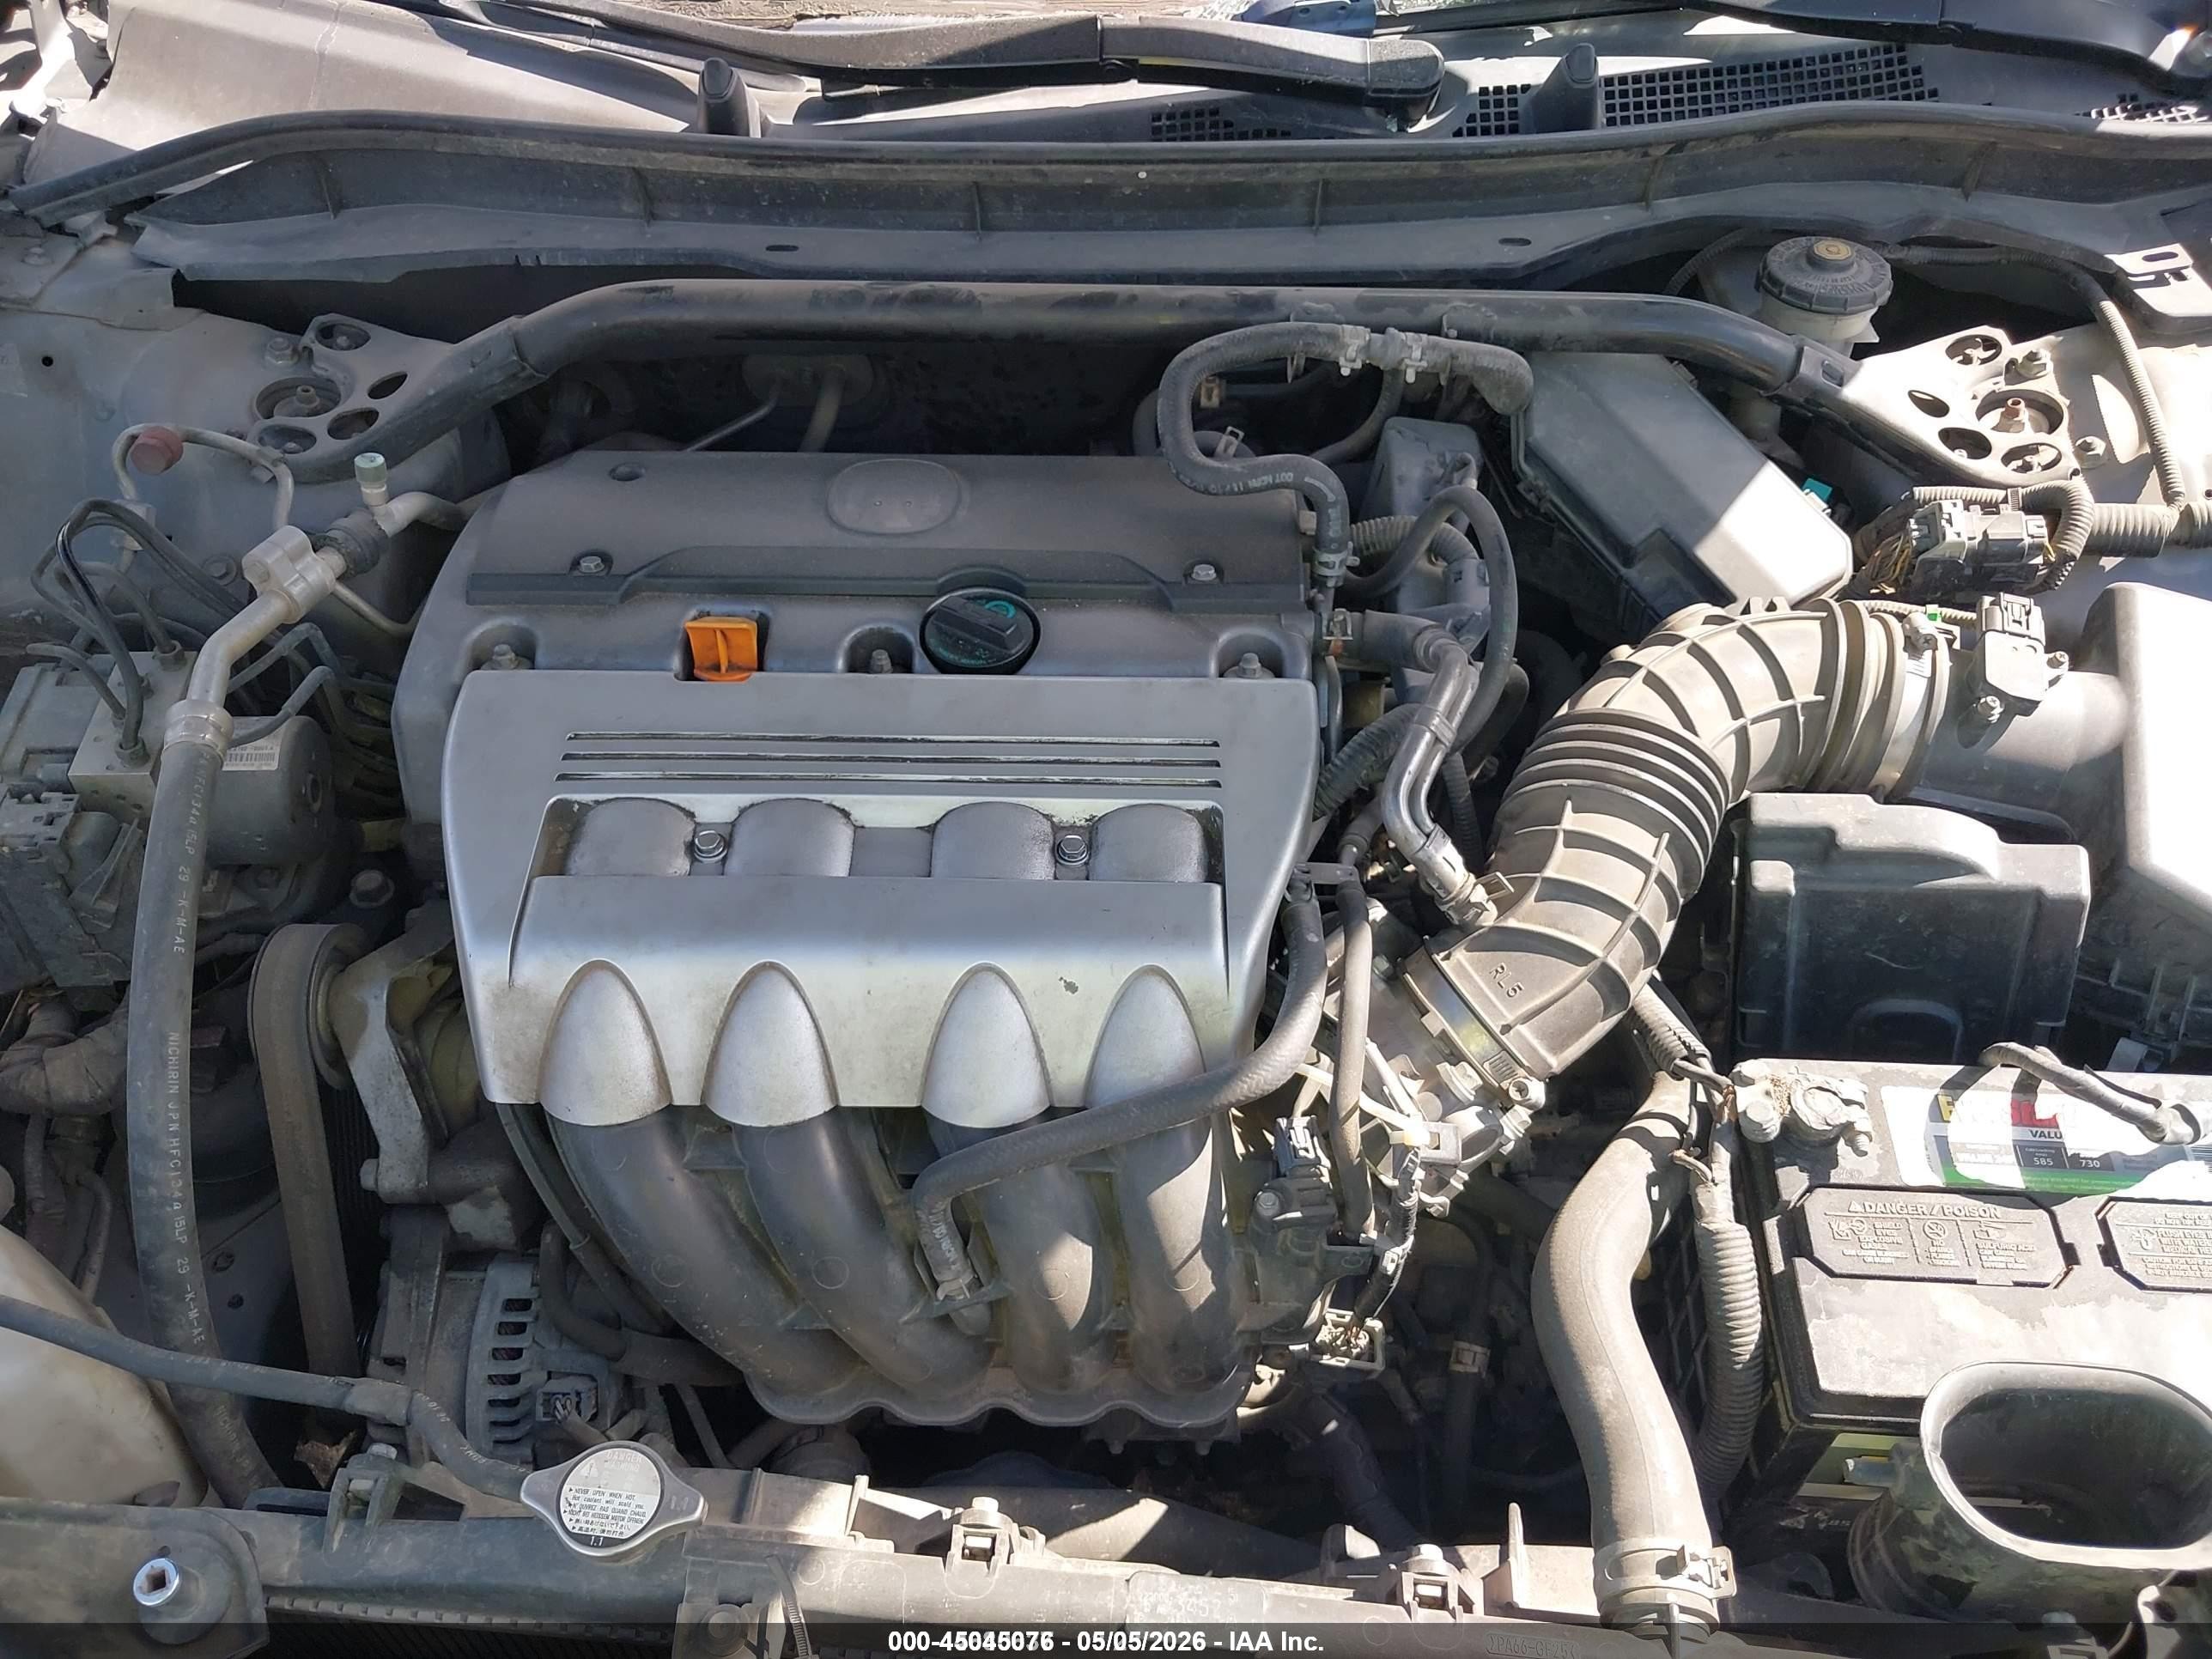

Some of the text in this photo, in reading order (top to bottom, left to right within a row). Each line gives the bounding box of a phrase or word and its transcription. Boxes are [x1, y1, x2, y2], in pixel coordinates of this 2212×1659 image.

[179, 866, 191, 883] 29
[167, 1031, 179, 1093] NICHIRIN
[167, 1102, 179, 1131] JPN
[2033, 1158, 2101, 1168] 585 730
[1863, 1201, 1928, 1216] DANGER
[1943, 1204, 2002, 1218] POISON
[177, 1257, 191, 1274] 29
[590, 1536, 605, 1547] 1.1
